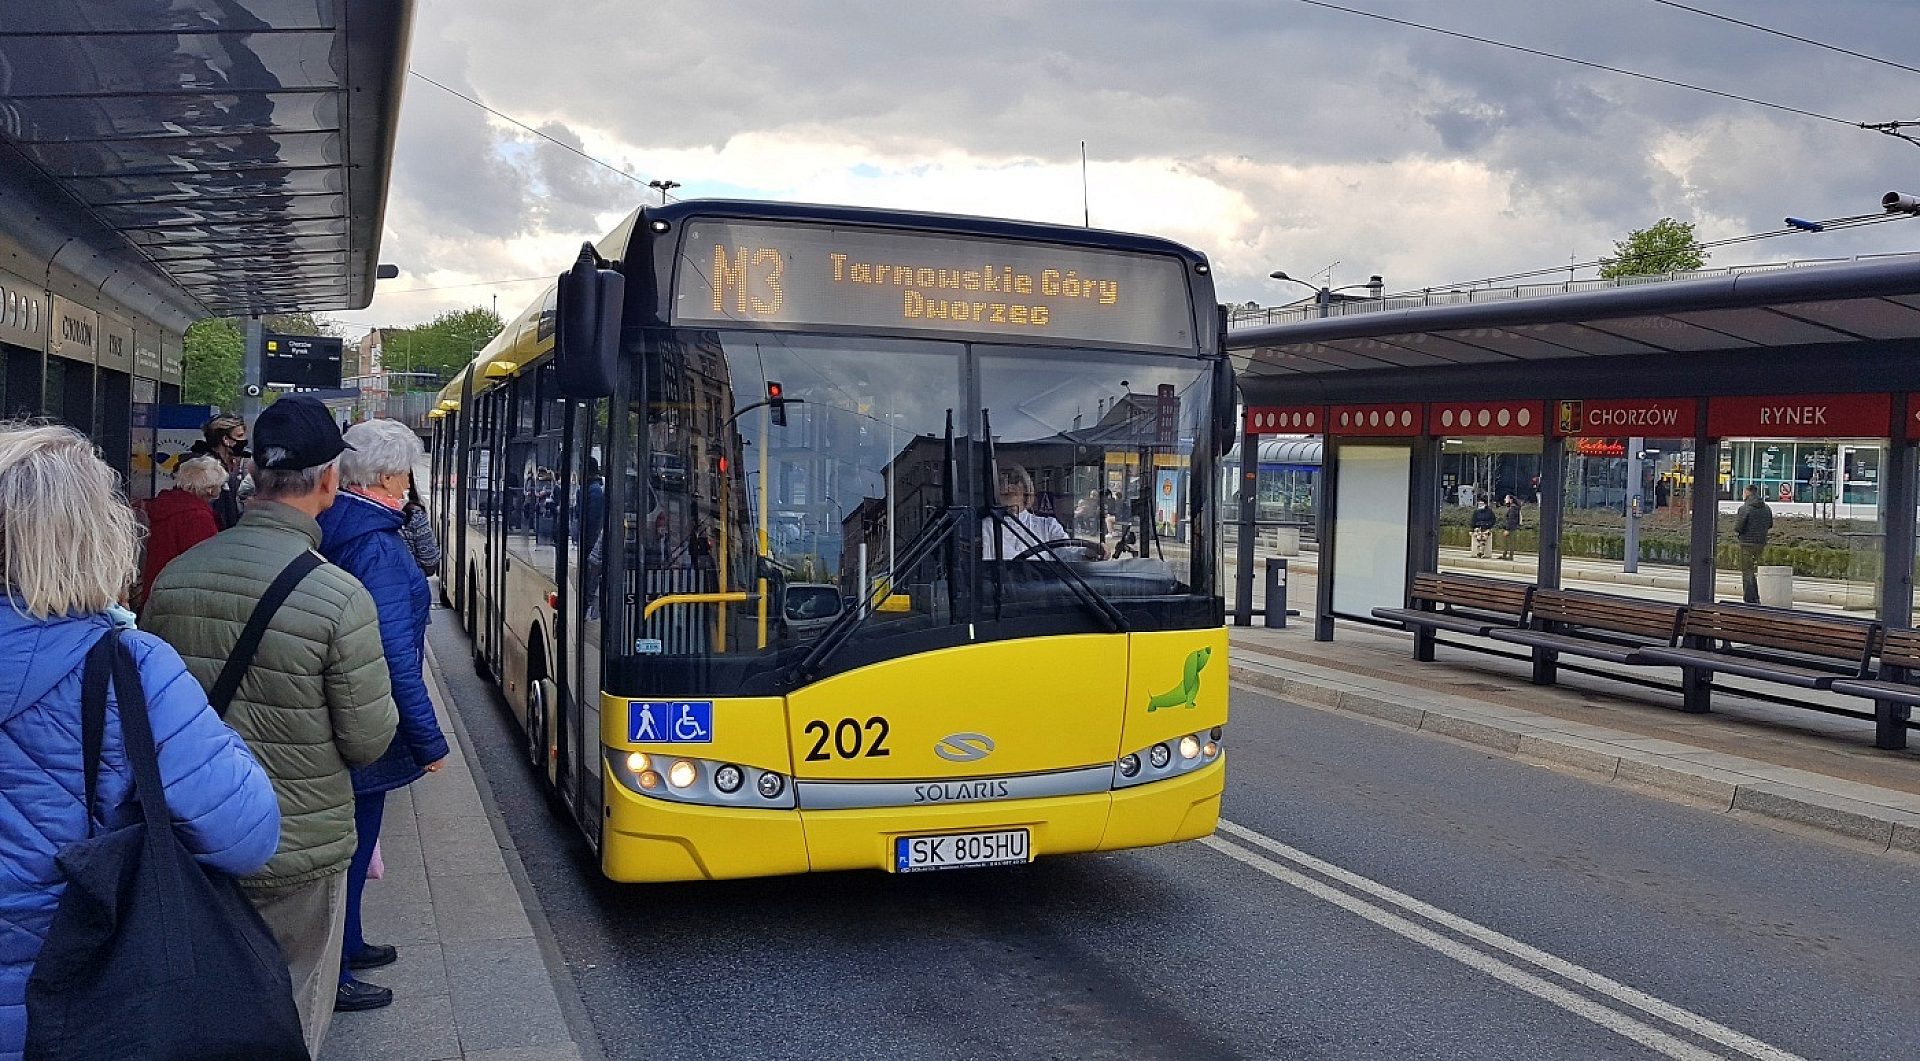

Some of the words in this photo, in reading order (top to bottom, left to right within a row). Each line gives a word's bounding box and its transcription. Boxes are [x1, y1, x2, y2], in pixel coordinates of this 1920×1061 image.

[711, 244, 784, 314] M3
[830, 253, 1033, 294] Tarnowskie
[1040, 268, 1118, 304] Góry
[903, 290, 1050, 325] Dworzec
[1589, 404, 1678, 426] CHORZÓW
[1760, 406, 1828, 425] RYNEK
[804, 716, 890, 762] 202
[913, 780, 1010, 803] SOLARIS
[912, 839, 947, 863] SK
[955, 833, 1024, 861] 805HU
